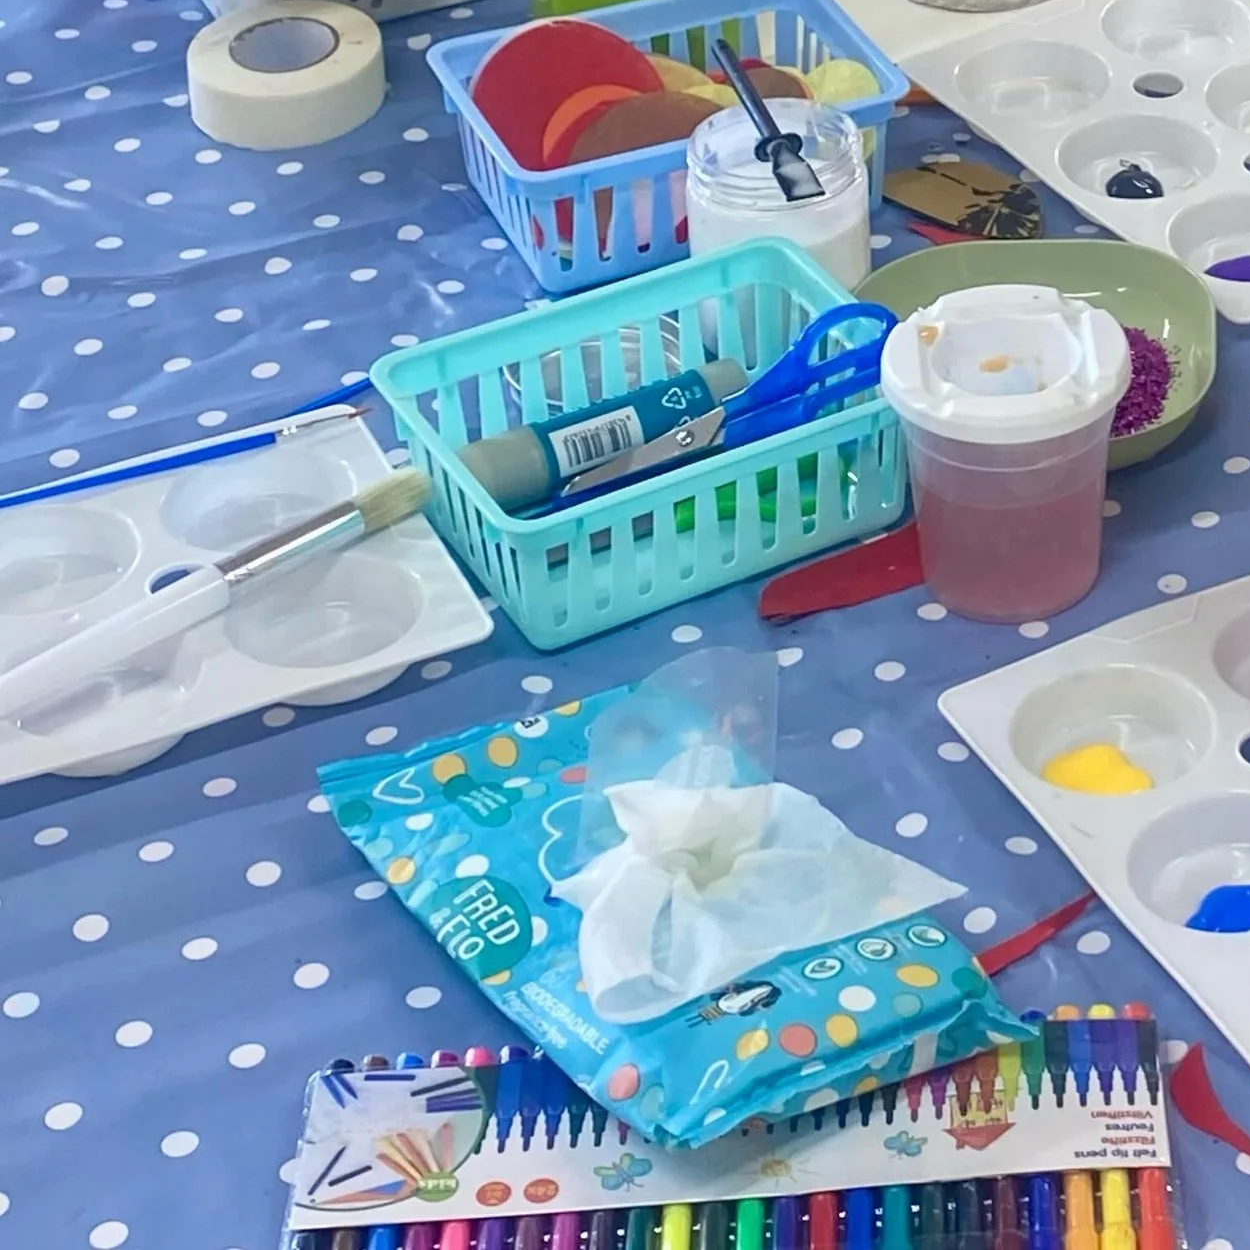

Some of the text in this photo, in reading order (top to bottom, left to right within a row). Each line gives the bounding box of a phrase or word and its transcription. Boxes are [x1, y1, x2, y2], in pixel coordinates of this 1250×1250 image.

[453, 879, 520, 945] FRED
[436, 914, 485, 960] FLO
[520, 981, 610, 1056] BIODEGRADABLE
[1105, 1123, 1155, 1132] Feutres
[1074, 1148, 1157, 1158] Felt tip pens
[418, 1178, 456, 1190] kids
